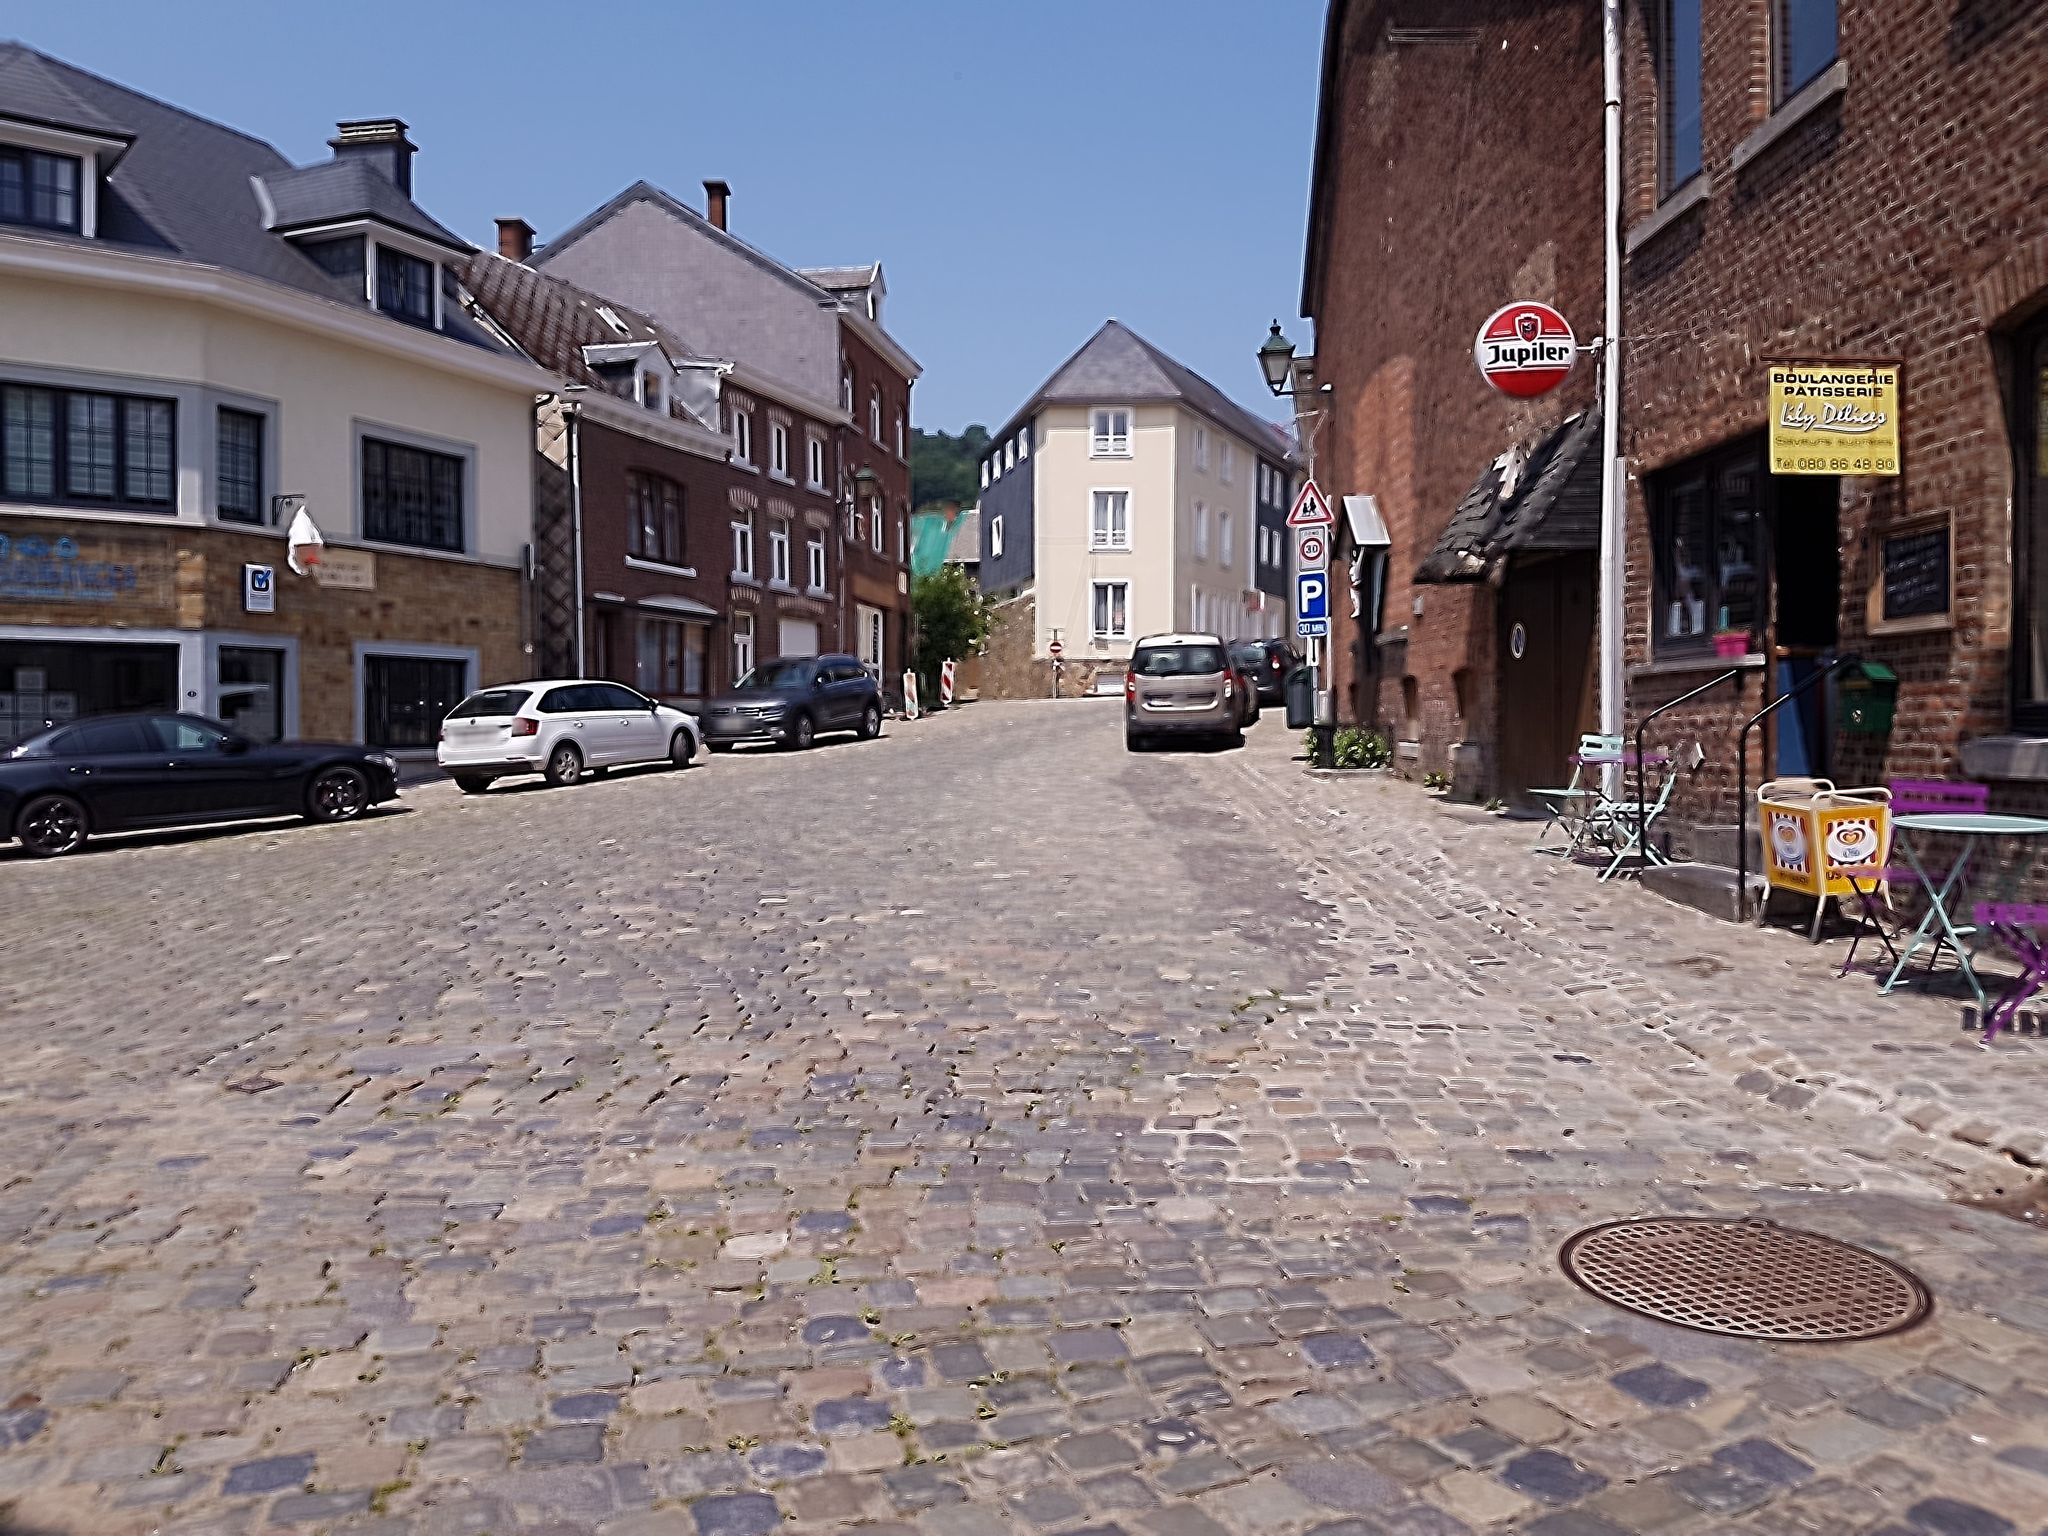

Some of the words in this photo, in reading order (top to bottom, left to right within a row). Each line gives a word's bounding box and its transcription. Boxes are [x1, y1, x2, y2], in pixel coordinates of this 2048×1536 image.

[1487, 342, 1570, 367] Jupiler
[1773, 373, 1894, 385] BOULANGERIE
[1784, 386, 1883, 397] PATISSERIE
[1780, 401, 1817, 432] Lily
[1798, 458, 1826, 470] 080
[1830, 458, 1849, 470] 86
[1853, 458, 1872, 470] 48
[1876, 458, 1895, 470] 80
[1305, 544, 1318, 554] 30
[1301, 580, 1323, 613] P
[1299, 623, 1310, 634] 30
